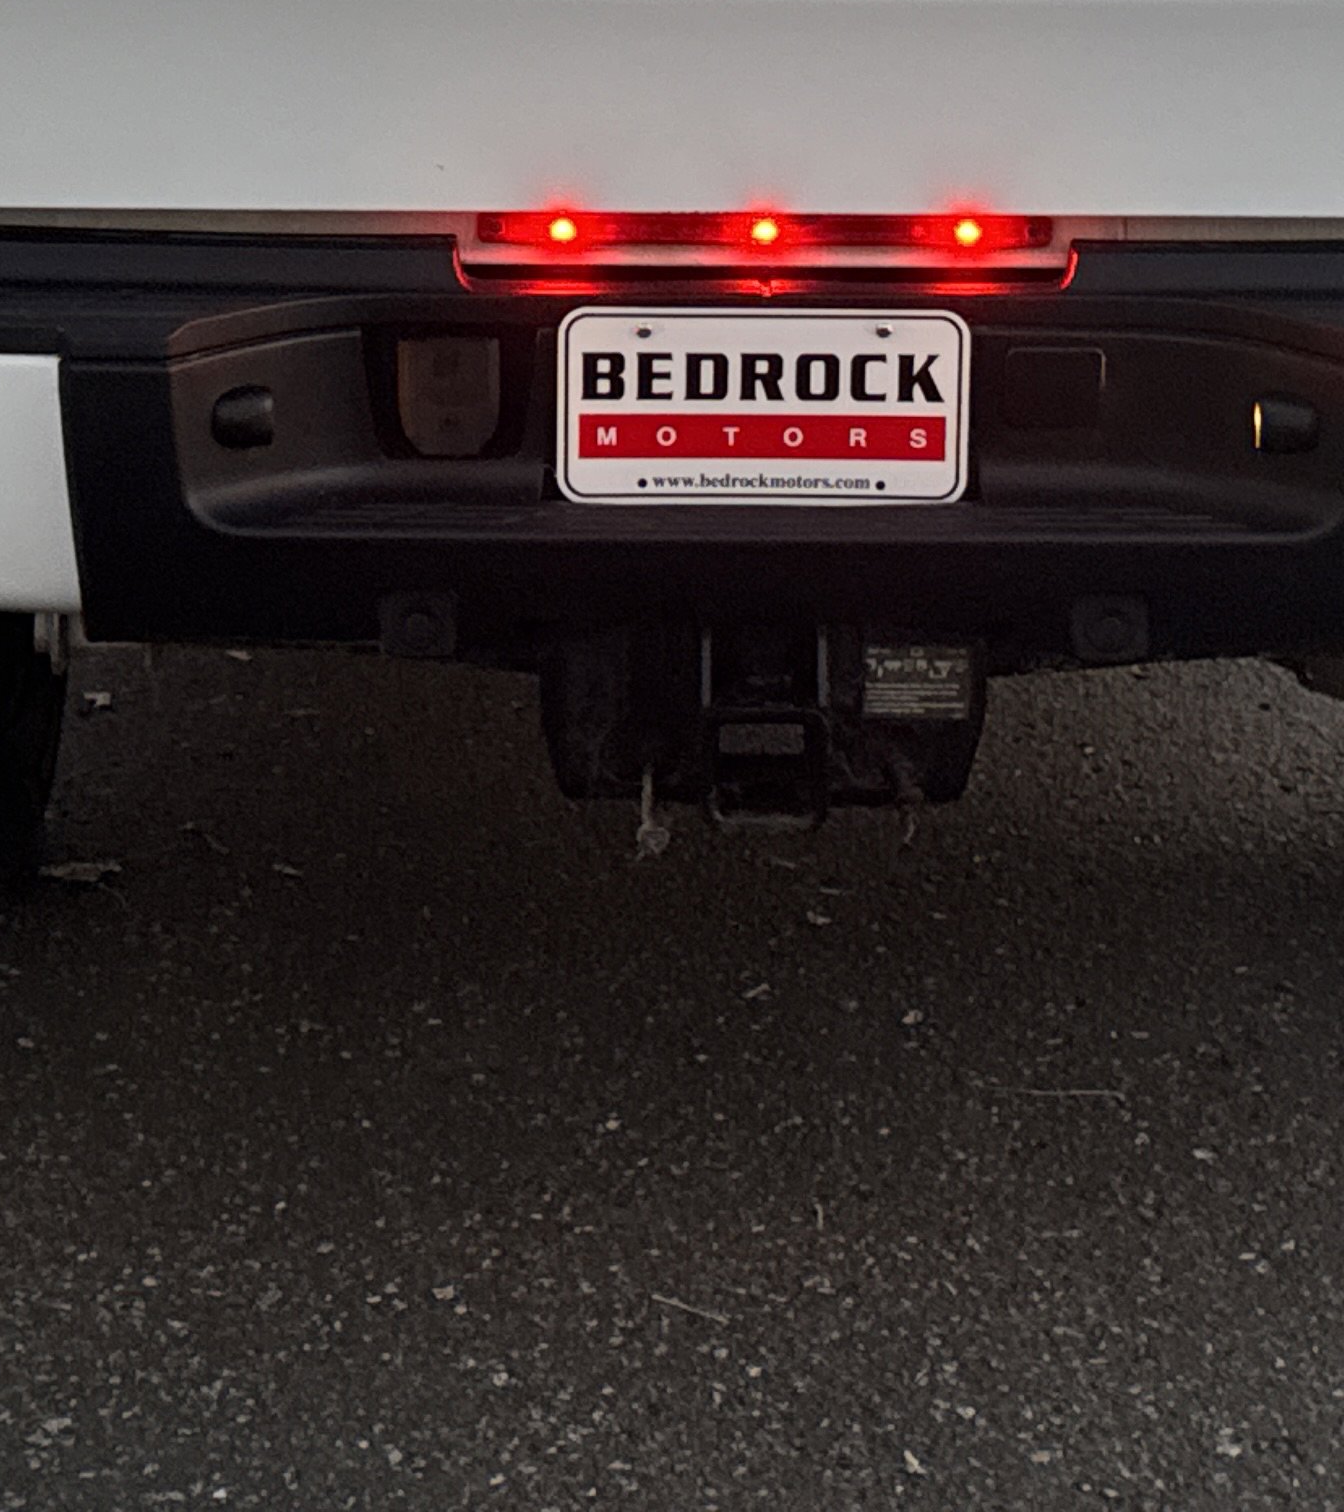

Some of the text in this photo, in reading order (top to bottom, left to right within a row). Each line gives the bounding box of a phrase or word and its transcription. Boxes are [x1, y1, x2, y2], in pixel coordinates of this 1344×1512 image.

[581, 352, 944, 403] BEDROCK
[597, 426, 927, 449] MOTORS
[652, 473, 870, 490] www.bedrockmotors.com
